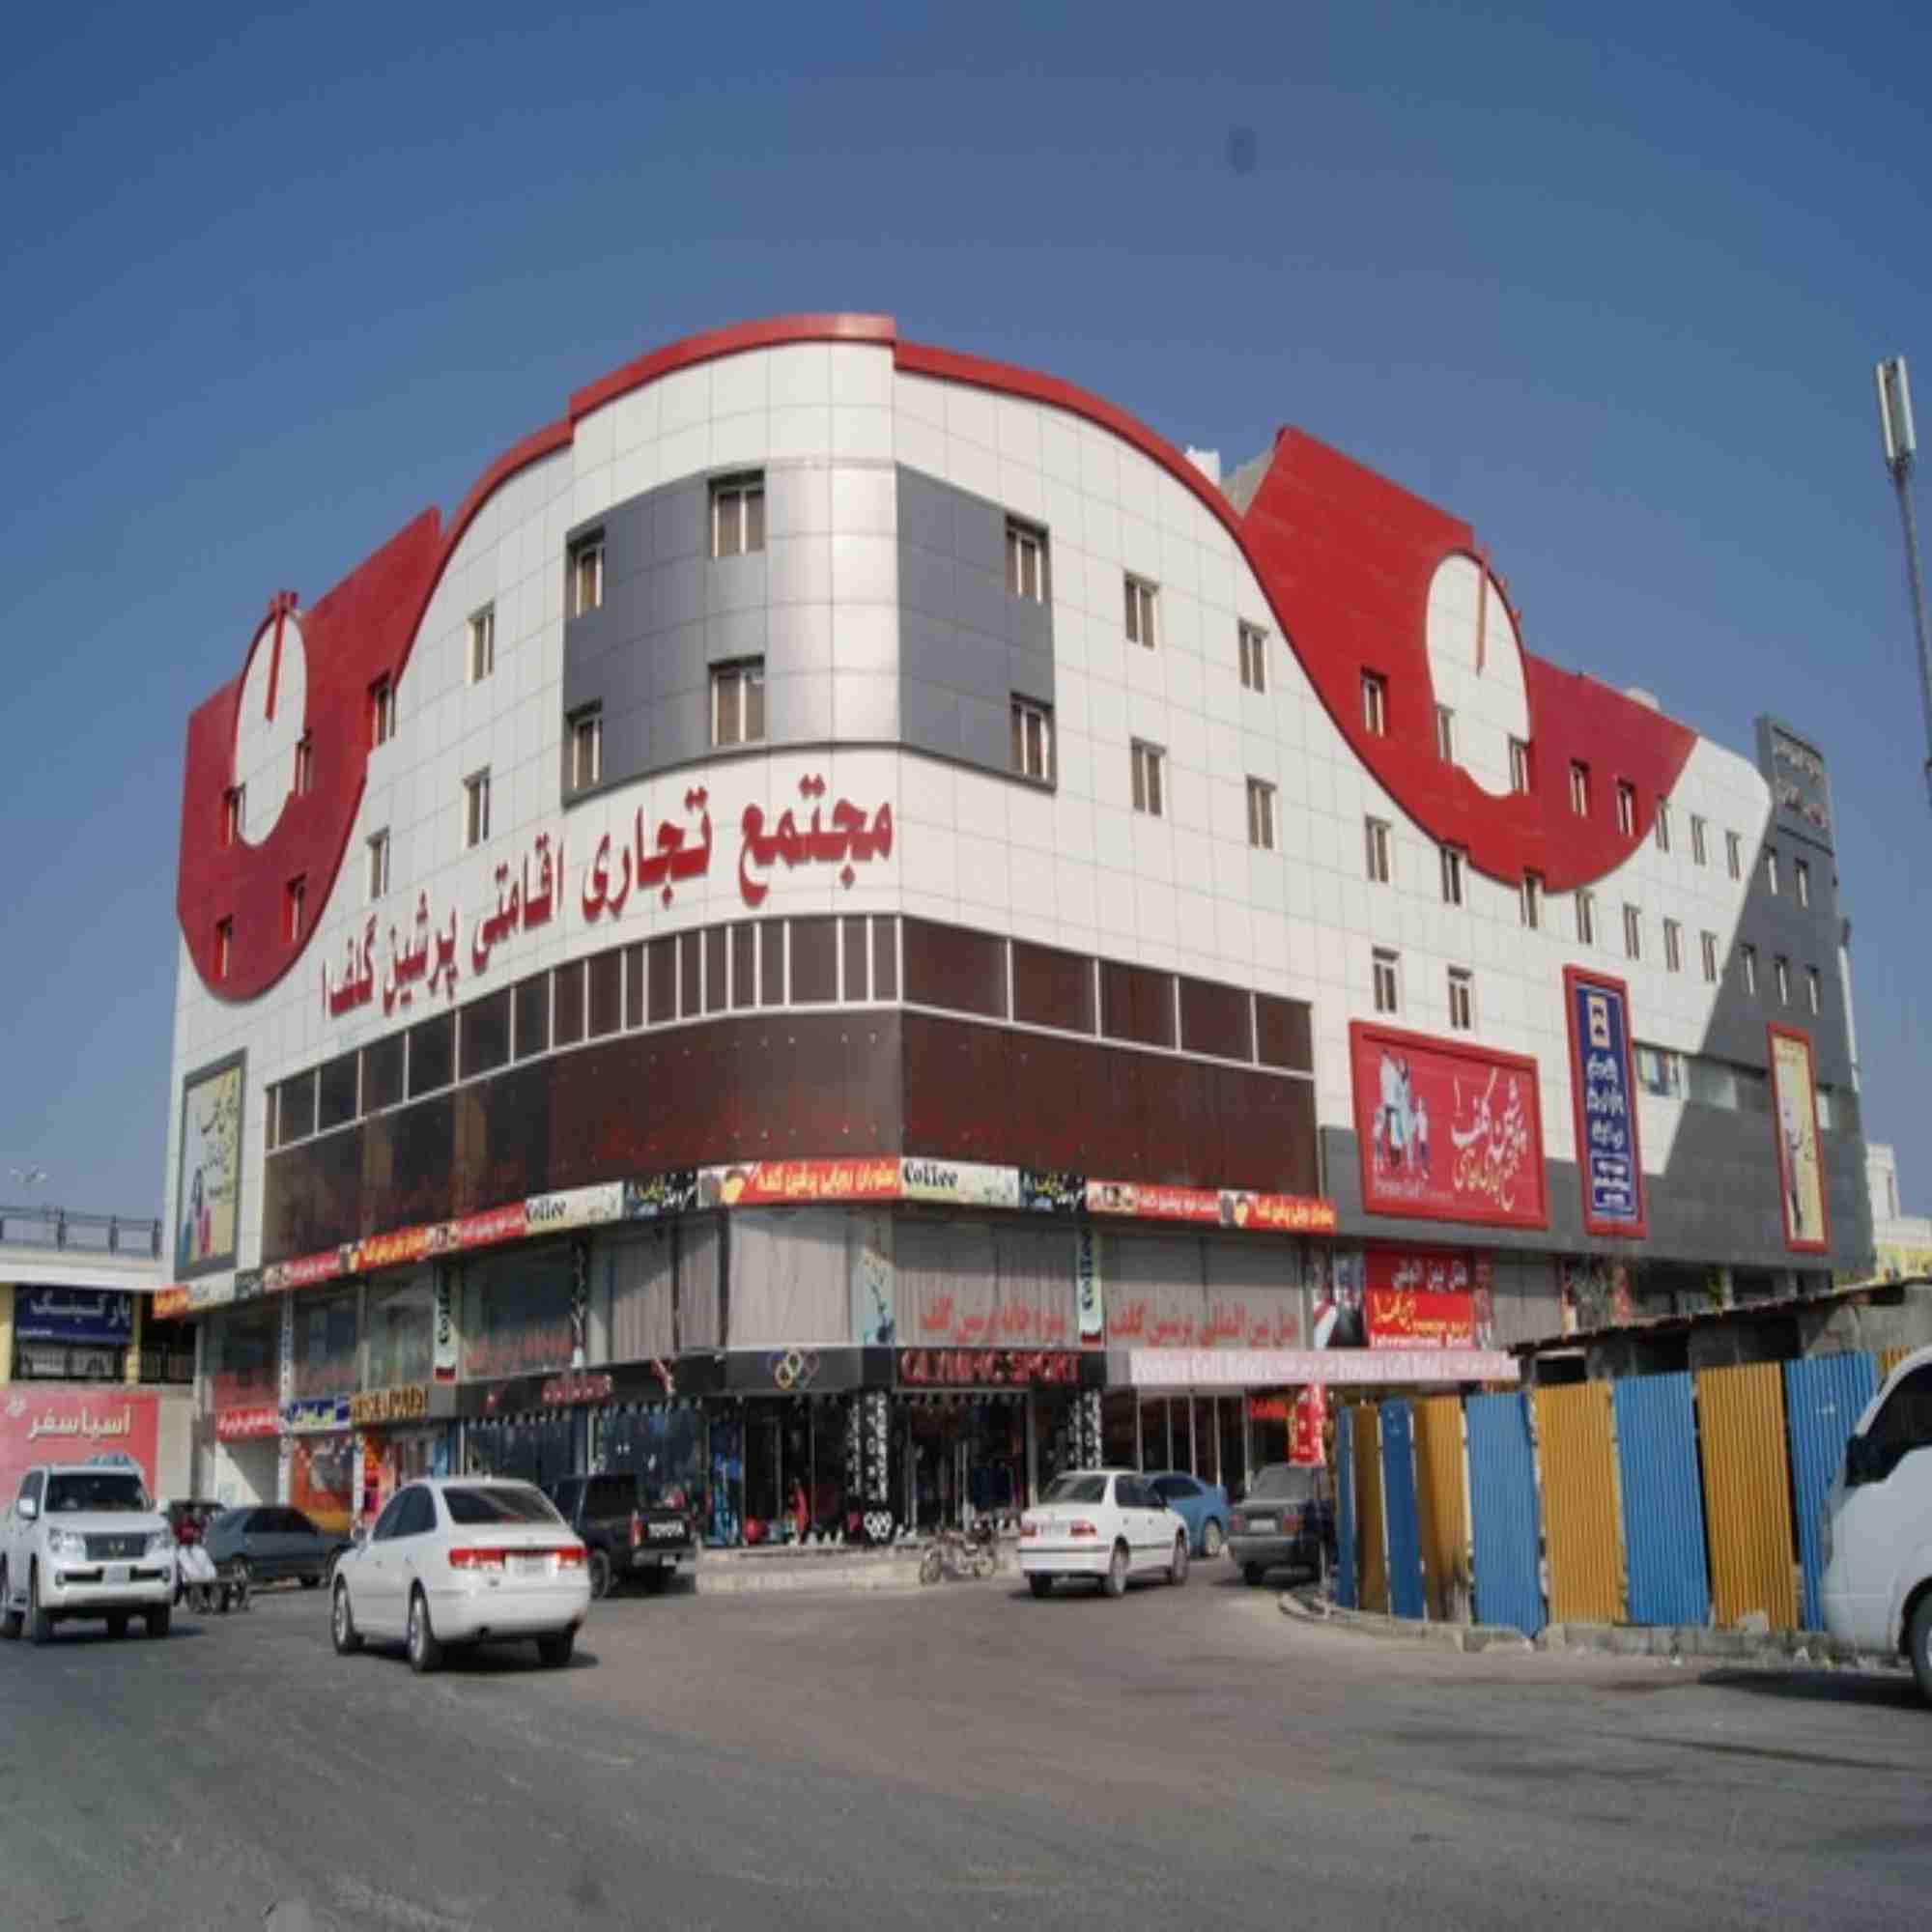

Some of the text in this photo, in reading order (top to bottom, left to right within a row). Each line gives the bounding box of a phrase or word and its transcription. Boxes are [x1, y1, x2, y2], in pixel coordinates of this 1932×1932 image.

[472, 833, 564, 970] اقامتی
[582, 786, 713, 923] تجاری
[739, 774, 894, 909] مجتمع
[384, 889, 459, 1016] پرشین
